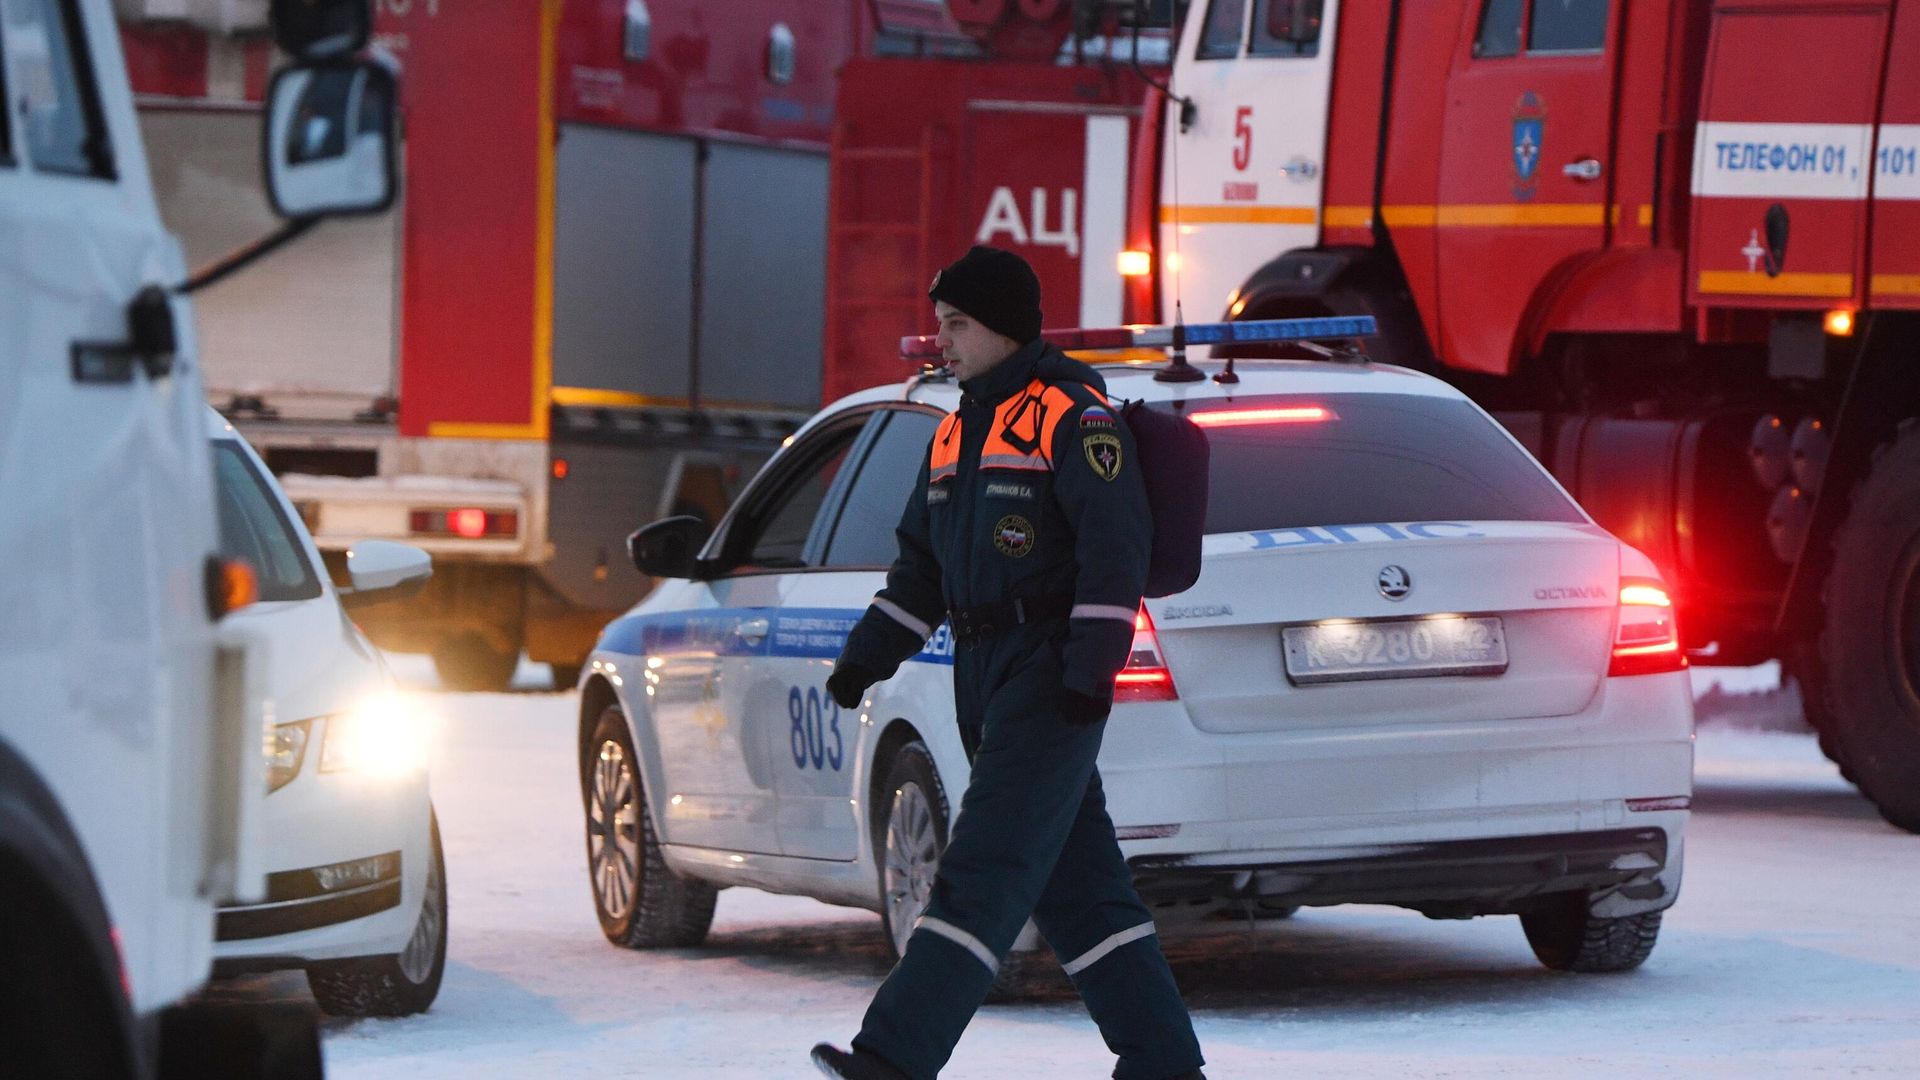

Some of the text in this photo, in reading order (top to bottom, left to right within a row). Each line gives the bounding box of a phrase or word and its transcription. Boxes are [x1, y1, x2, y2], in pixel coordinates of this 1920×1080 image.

[1233, 105, 1253, 172] 5
[1716, 141, 1817, 171] ТЕЛЕФОН
[1879, 146, 1916, 174] 101
[976, 186, 1079, 256] АЦ
[1250, 522, 1486, 550] ДПС
[1534, 586, 1607, 600] OCTAVIA
[789, 685, 842, 771] 803
